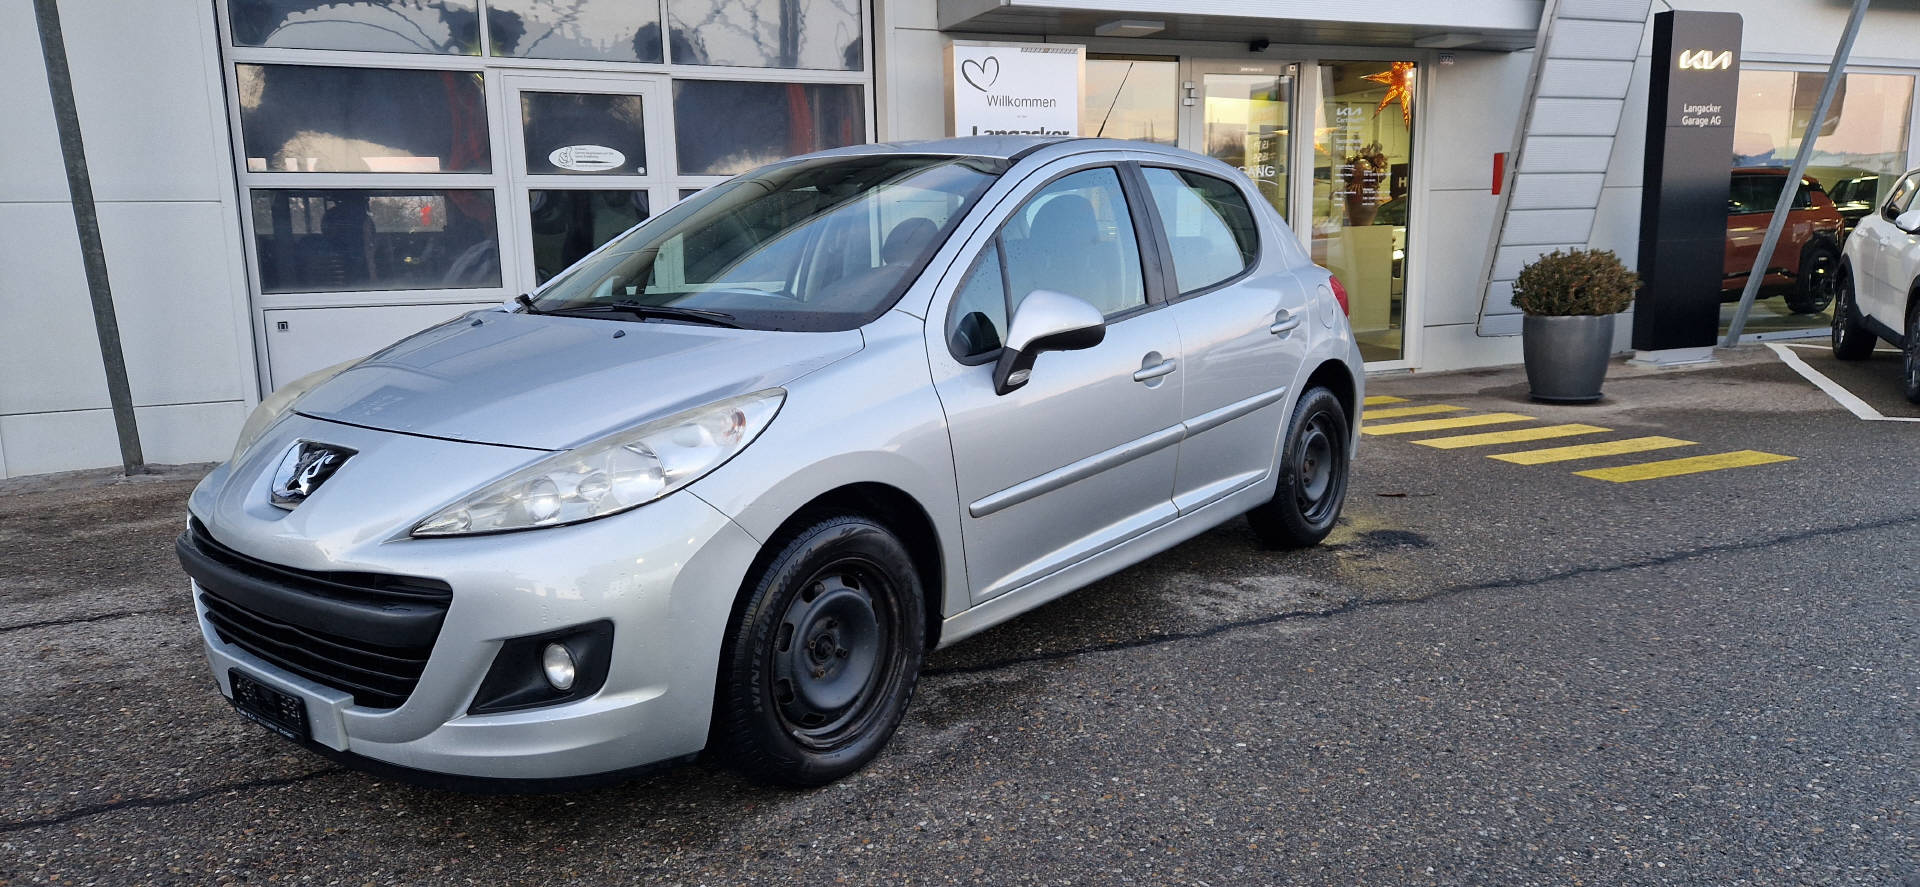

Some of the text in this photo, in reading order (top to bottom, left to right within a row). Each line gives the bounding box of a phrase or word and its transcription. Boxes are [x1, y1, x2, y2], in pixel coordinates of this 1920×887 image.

[986, 94, 1057, 108] Willkommen
[1683, 103, 1721, 115] Langacker
[1681, 115, 1722, 128] Garage AG
